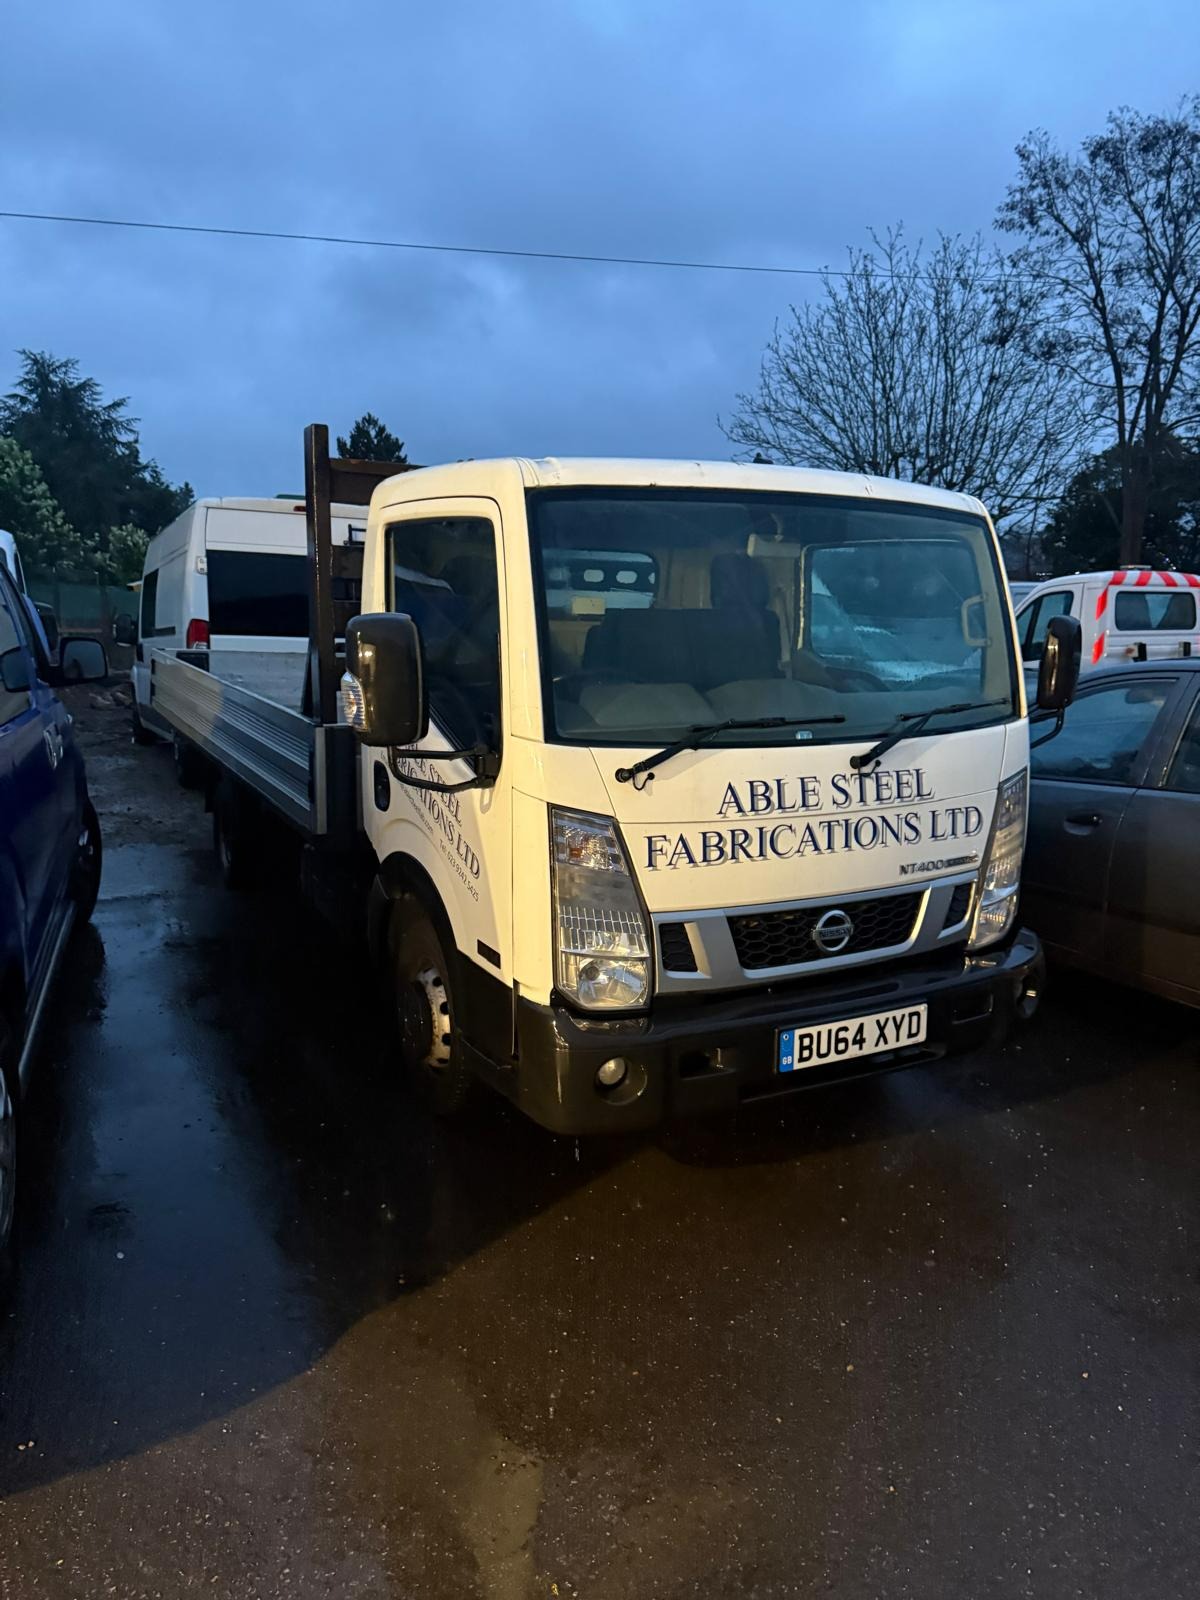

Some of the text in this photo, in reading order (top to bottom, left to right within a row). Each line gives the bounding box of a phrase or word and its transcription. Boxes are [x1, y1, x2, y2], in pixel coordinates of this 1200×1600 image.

[717, 768, 936, 819] ABLE STEEL
[456, 833, 481, 880] LTD
[644, 805, 984, 873] FABRICATIONS LTD
[898, 859, 944, 876] NT400
[782, 1055, 793, 1066] GB
[797, 1010, 921, 1064] BU64 XYD
